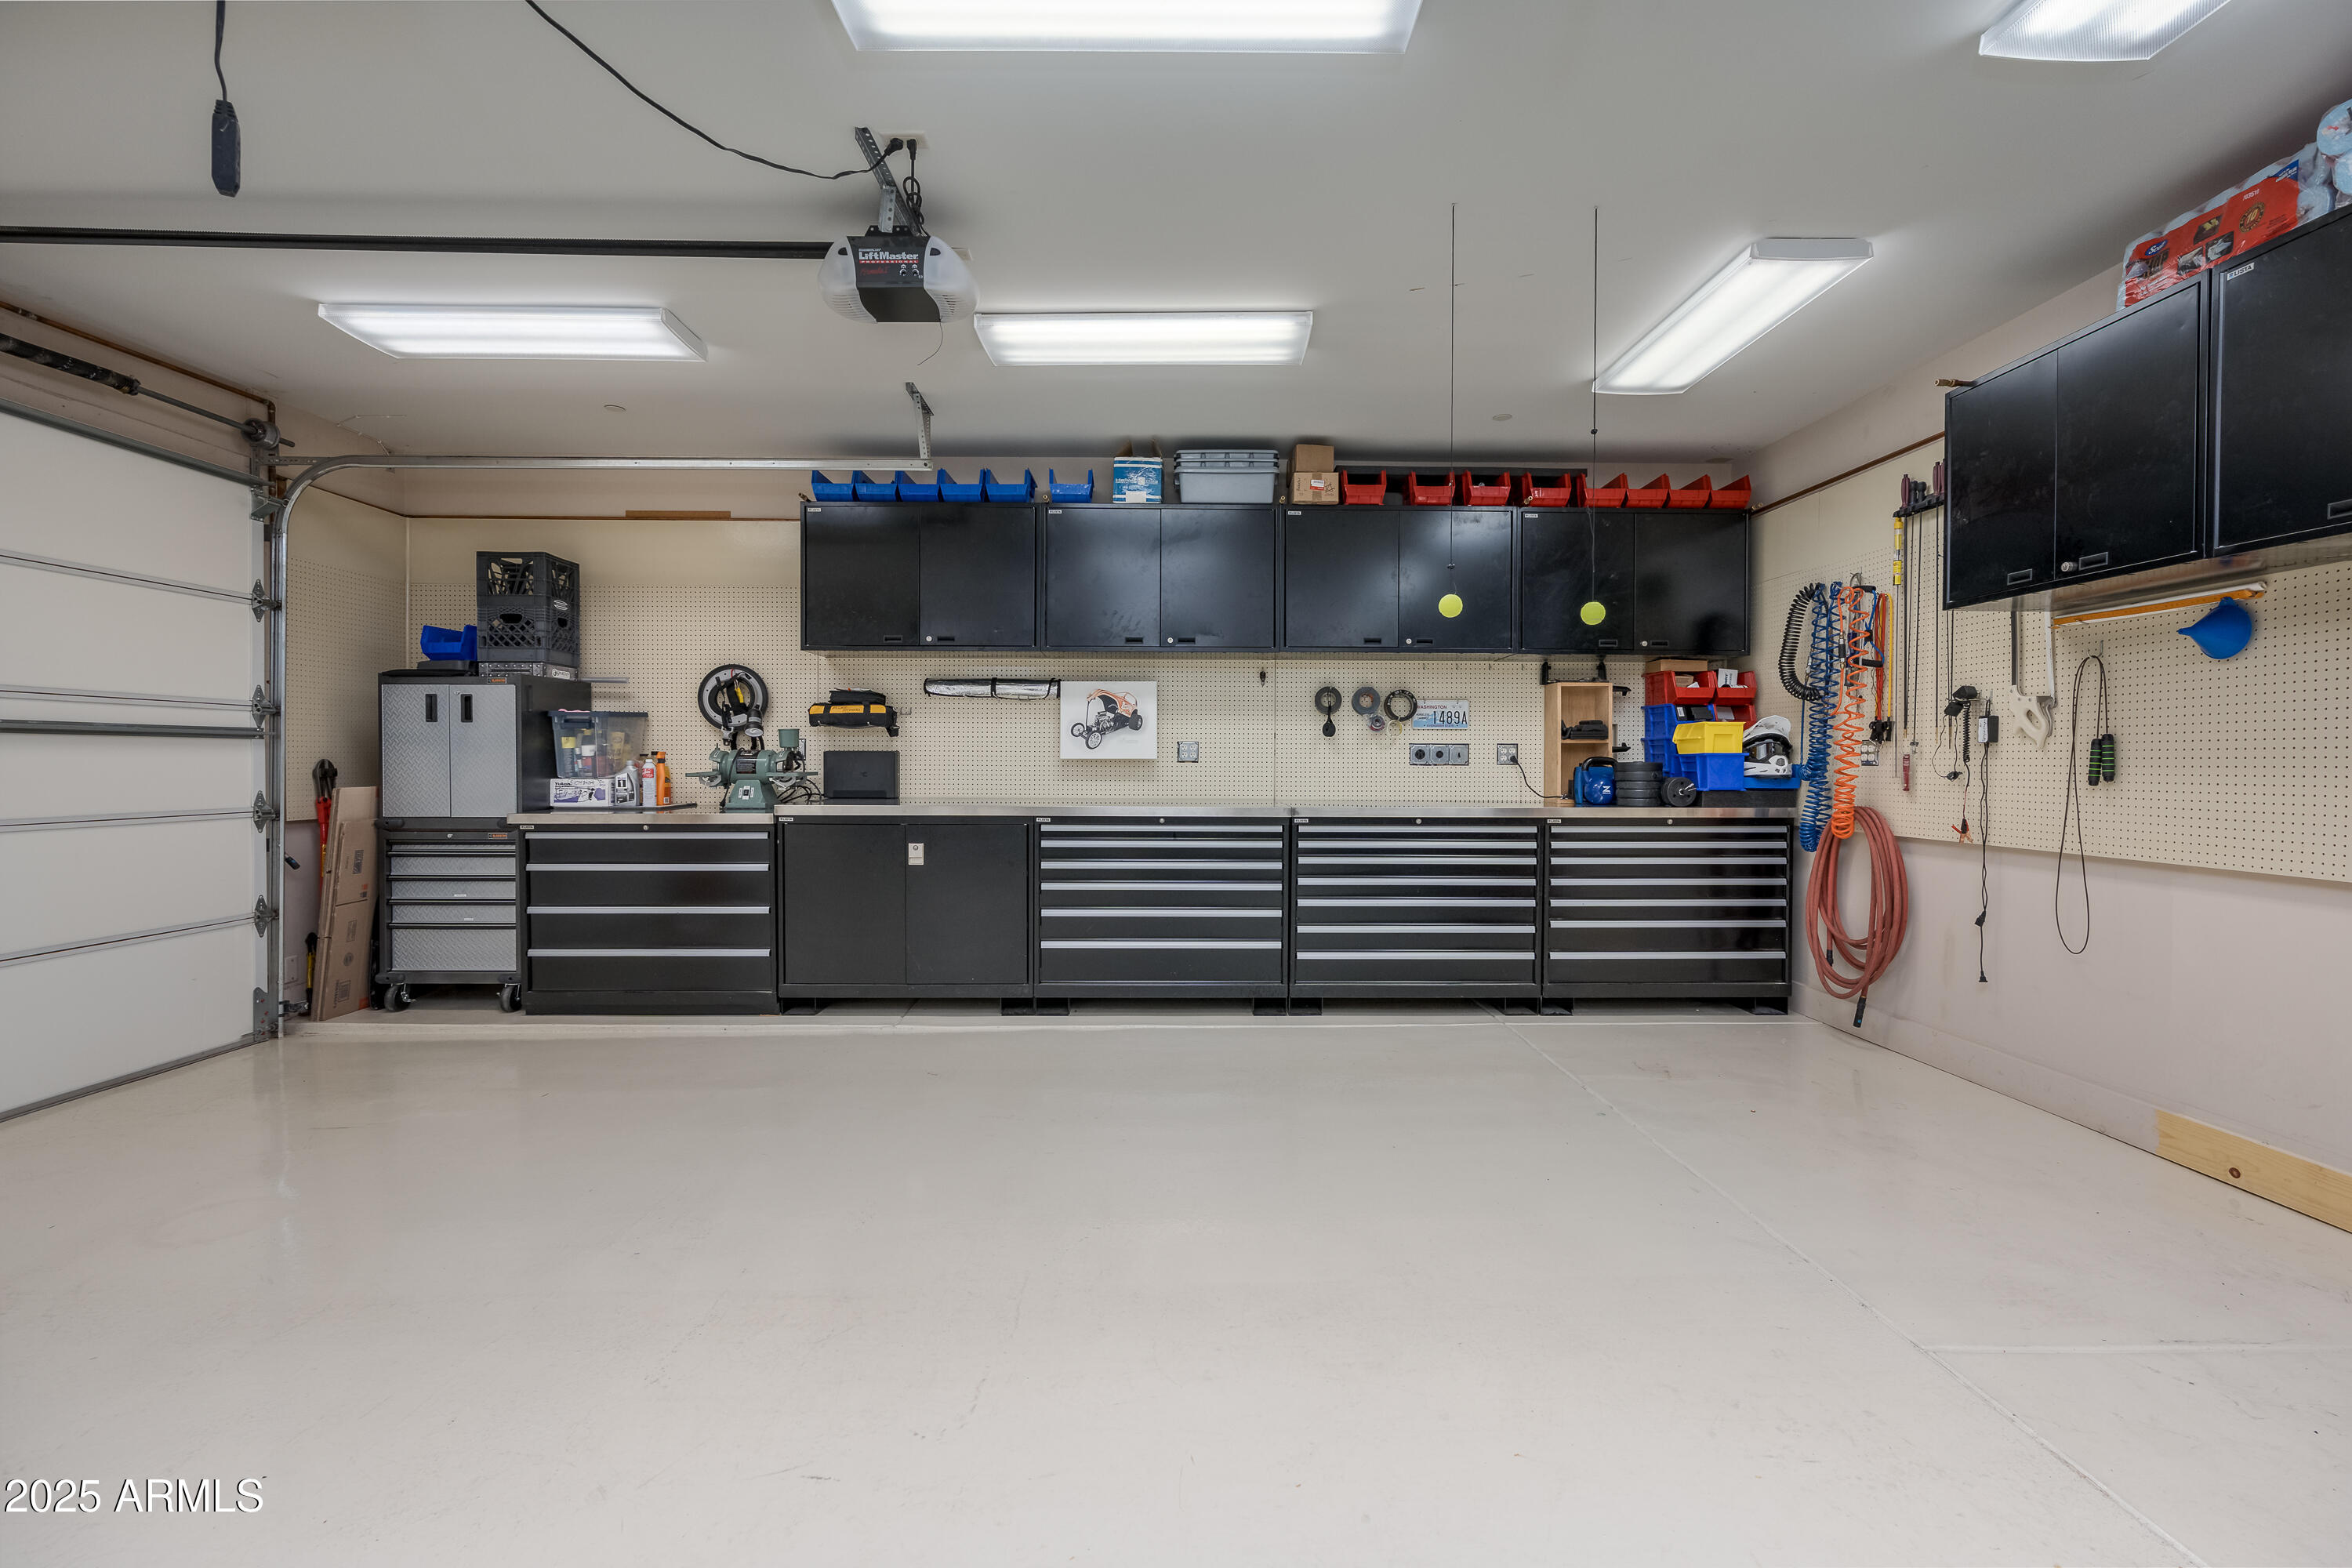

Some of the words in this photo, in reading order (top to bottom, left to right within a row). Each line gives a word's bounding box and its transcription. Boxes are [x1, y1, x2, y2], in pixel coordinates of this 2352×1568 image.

[2246, 209, 2259, 224] 10
[858, 251, 919, 260] LiftMaster
[2234, 265, 2253, 276] LISTA
[1433, 710, 1468, 724] 1489A
